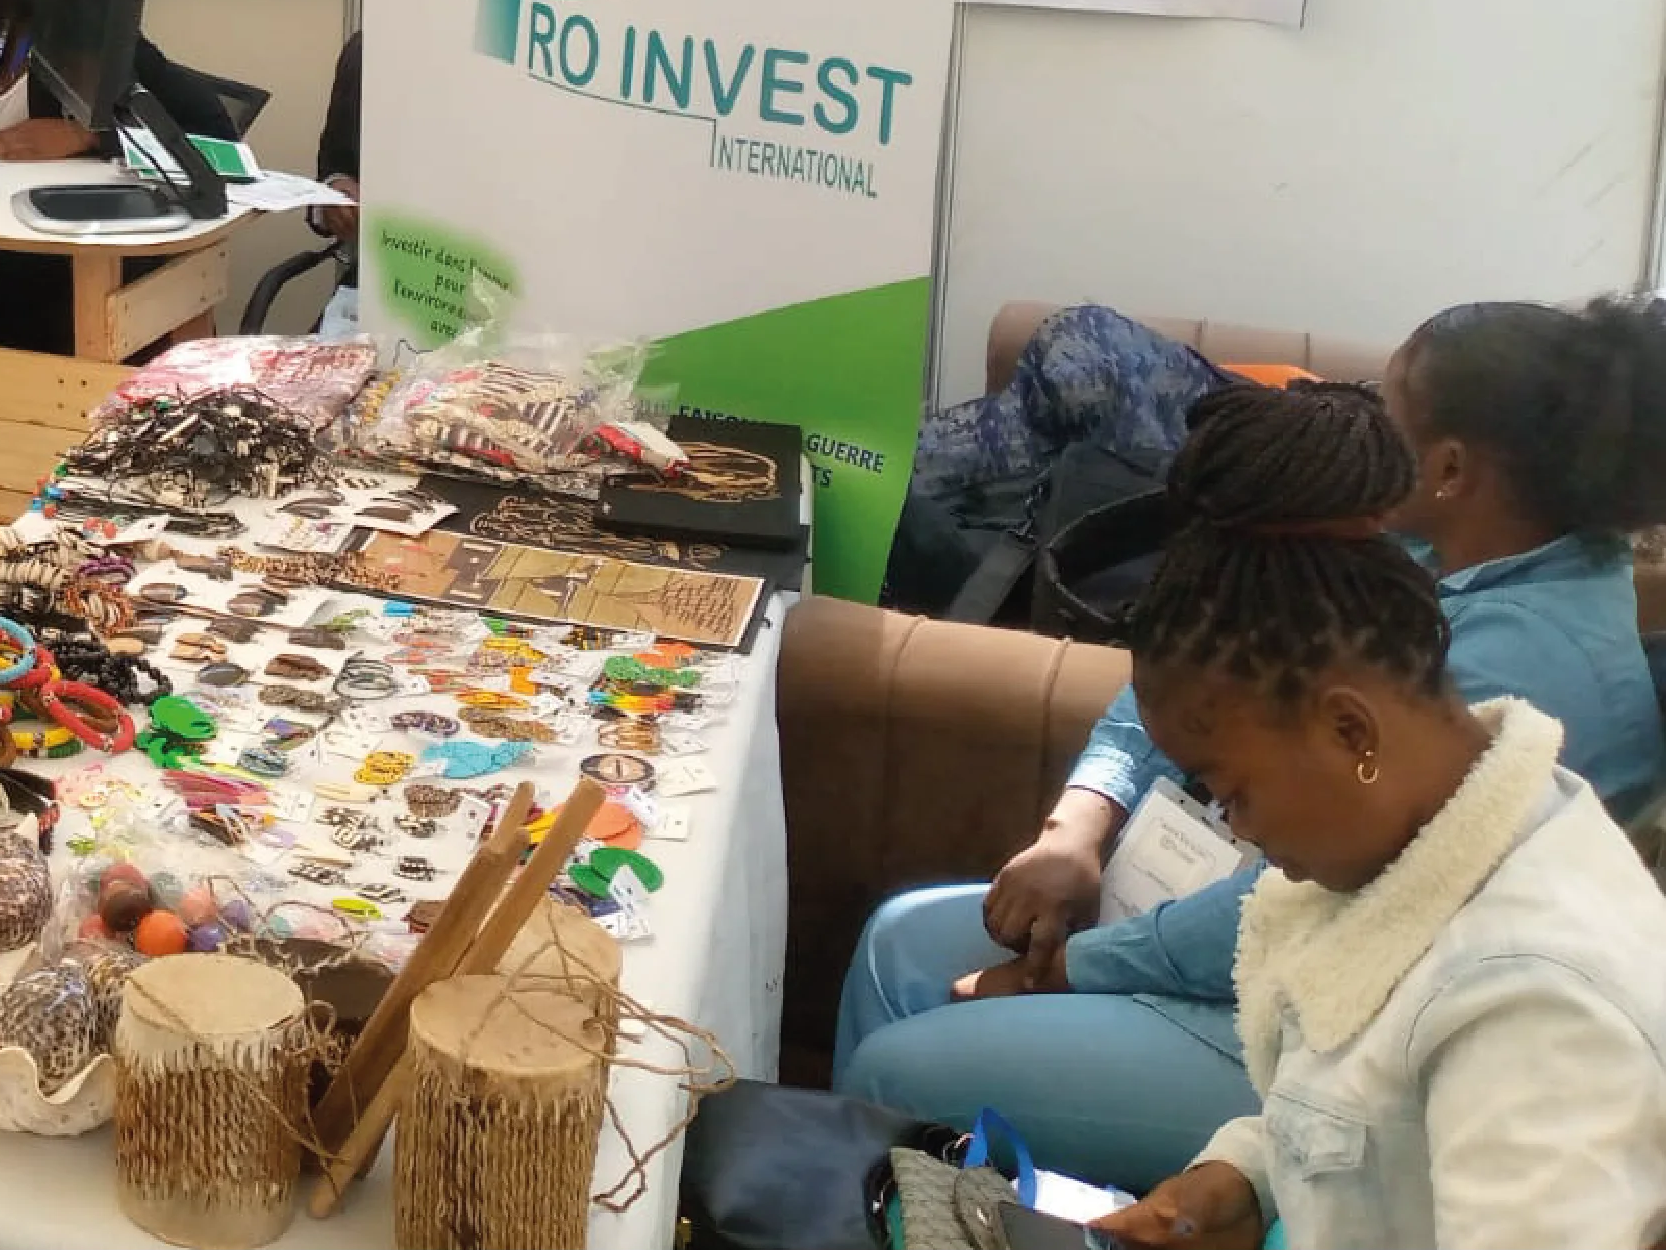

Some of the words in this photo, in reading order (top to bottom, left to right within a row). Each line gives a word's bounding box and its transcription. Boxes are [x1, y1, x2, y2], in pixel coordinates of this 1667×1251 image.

[618, 25, 914, 146] INVEST
[434, 273, 466, 296] pour
[807, 432, 887, 475] GUERRE
